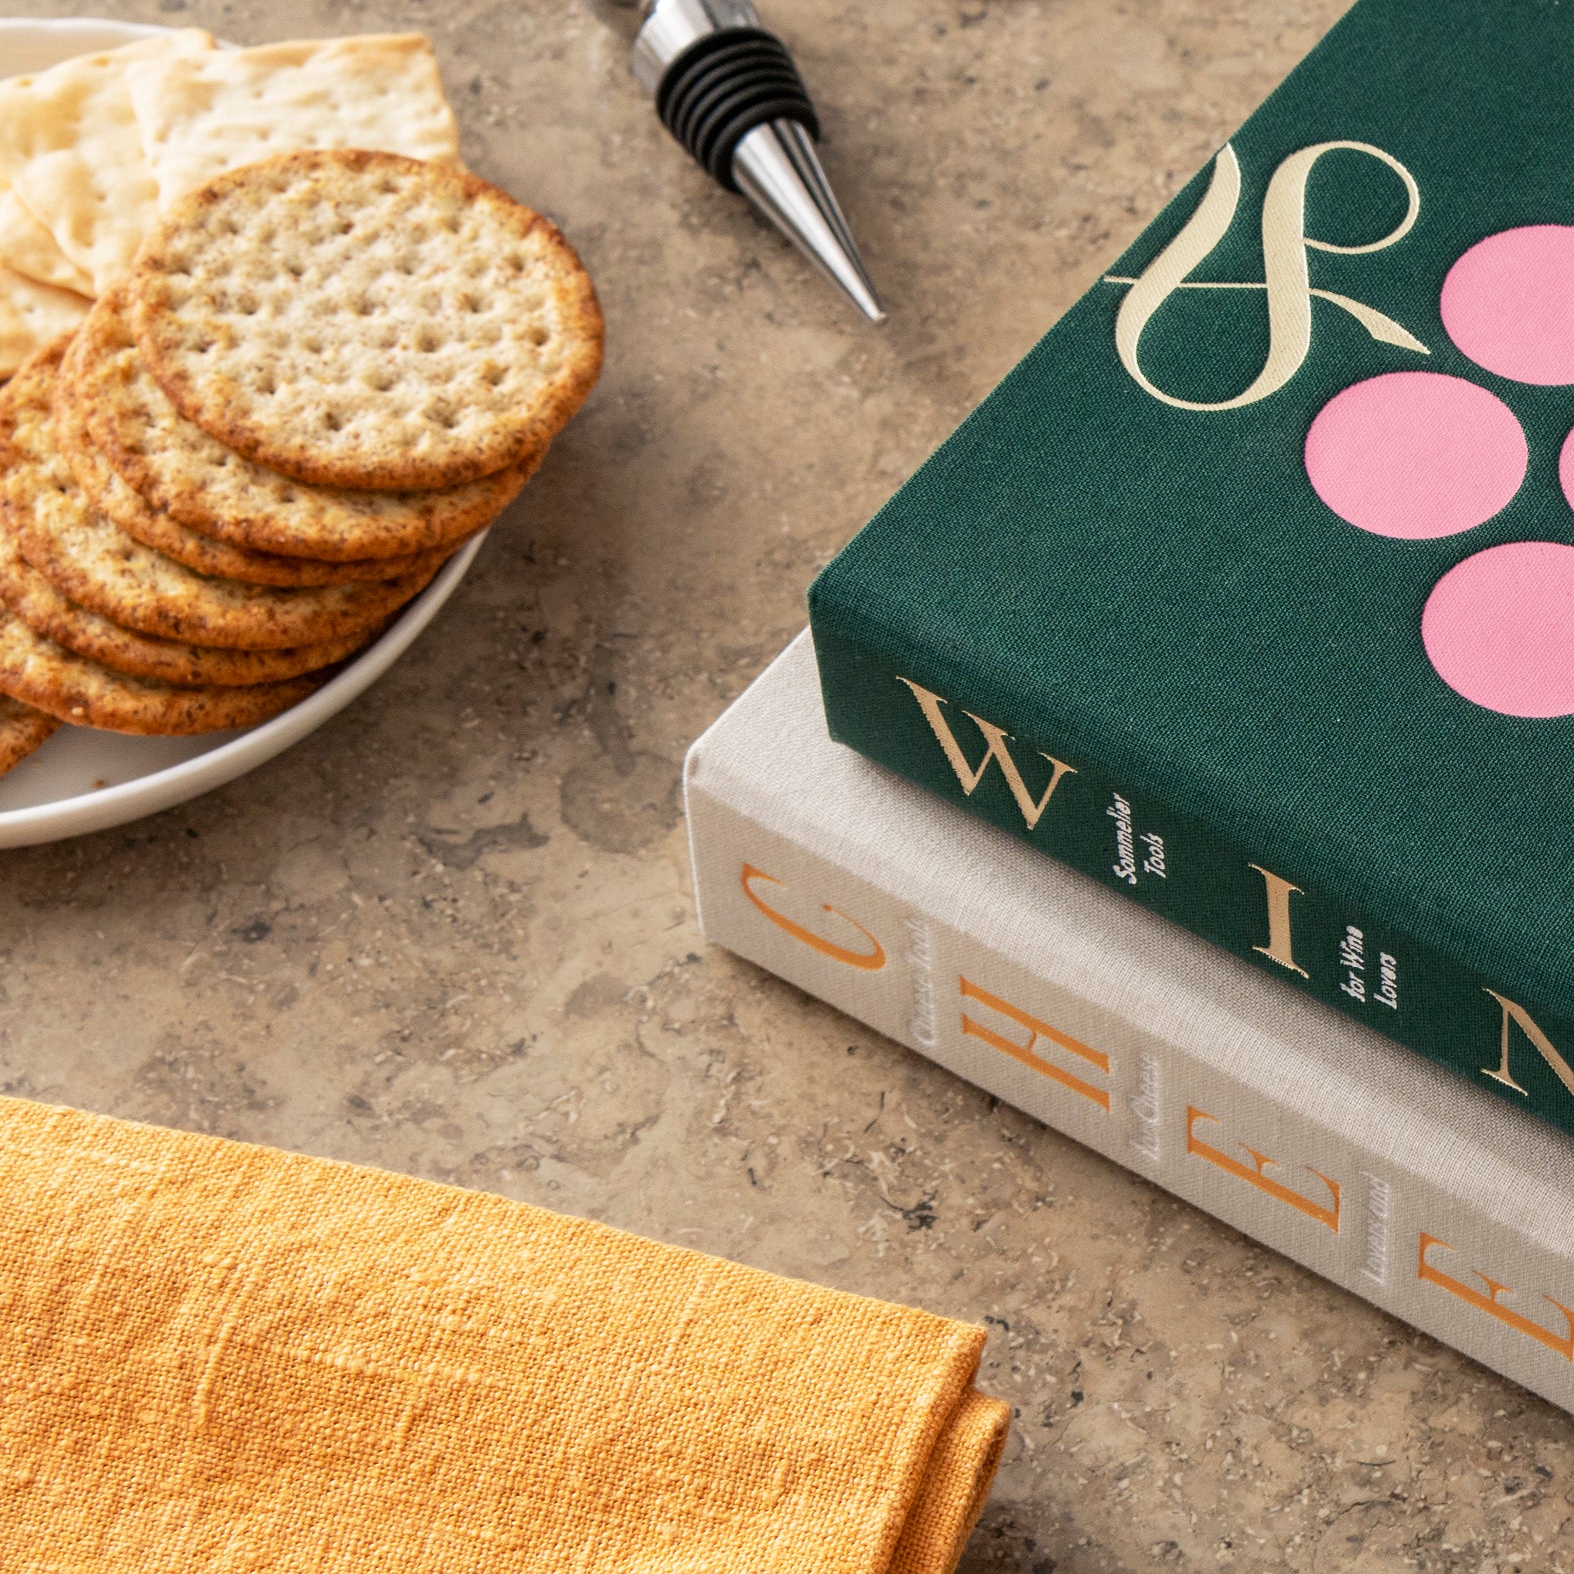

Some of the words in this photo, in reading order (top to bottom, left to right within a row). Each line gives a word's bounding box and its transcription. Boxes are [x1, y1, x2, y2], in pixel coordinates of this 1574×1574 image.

[1105, 792, 1137, 885] Sommelier
[1140, 832, 1167, 879] Tools
[1338, 925, 1364, 971] Wine
[1339, 970, 1366, 1003] for
[1373, 951, 1398, 1010] Lovers
